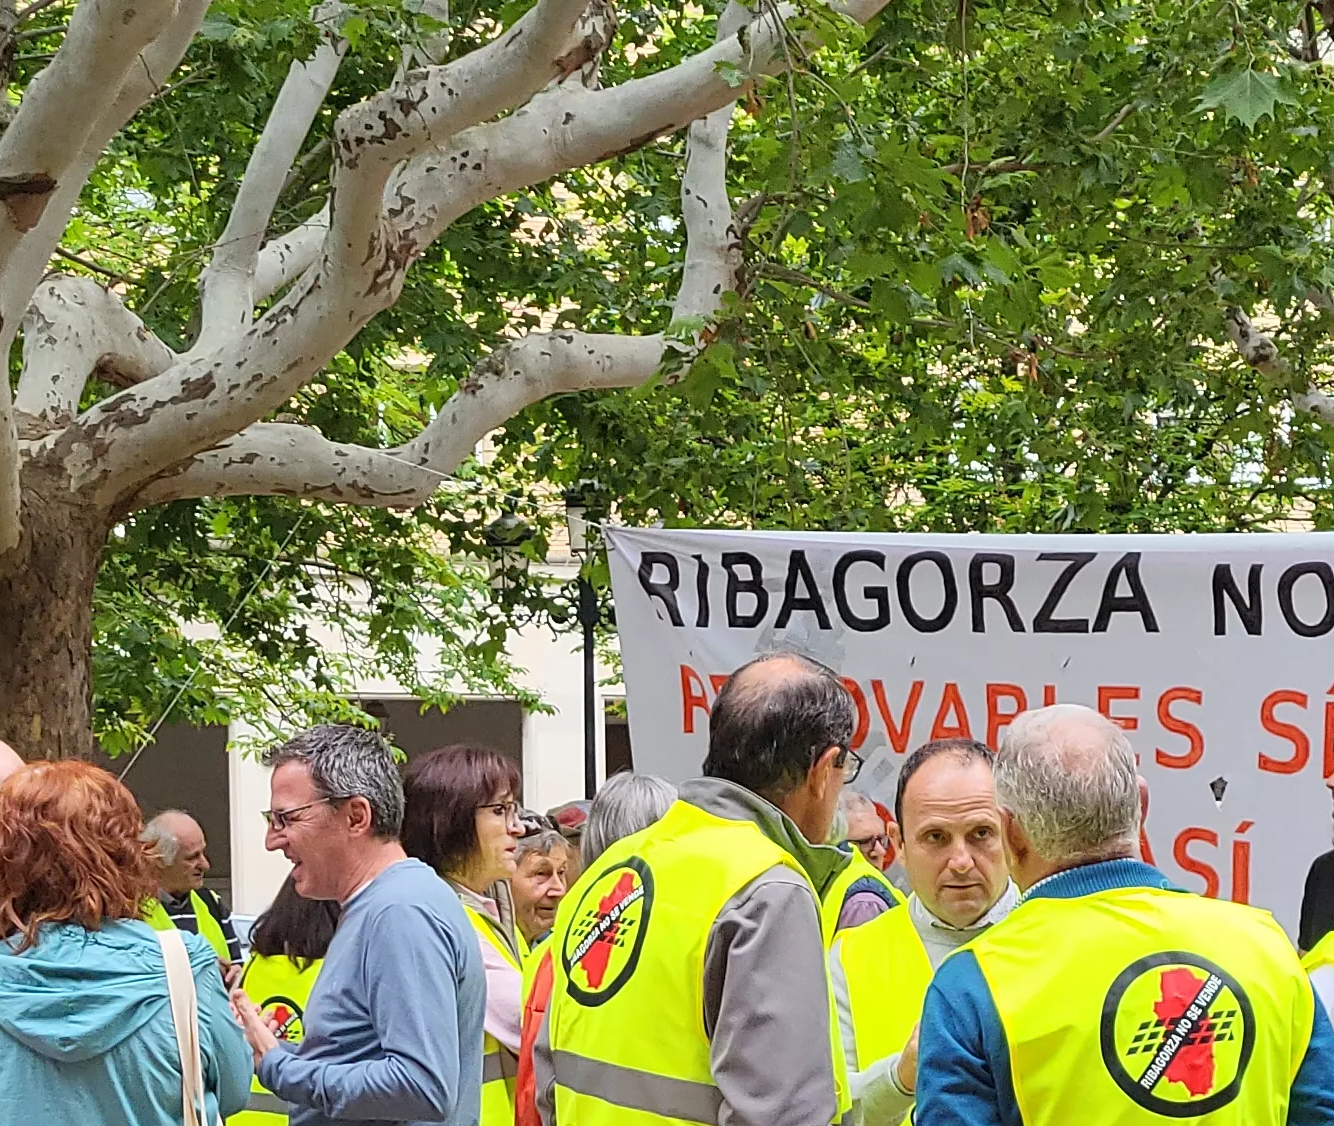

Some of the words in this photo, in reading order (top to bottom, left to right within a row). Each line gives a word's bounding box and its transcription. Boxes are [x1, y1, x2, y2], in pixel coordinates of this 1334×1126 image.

[638, 548, 1160, 634] RIBAGORZA
[1139, 820, 1255, 905] SÍ
[1140, 1033, 1182, 1090] RIBAGORZA
[1175, 1018, 1192, 1036] NO
[1186, 1004, 1203, 1020] SE
[1196, 974, 1222, 1007] VENDE
